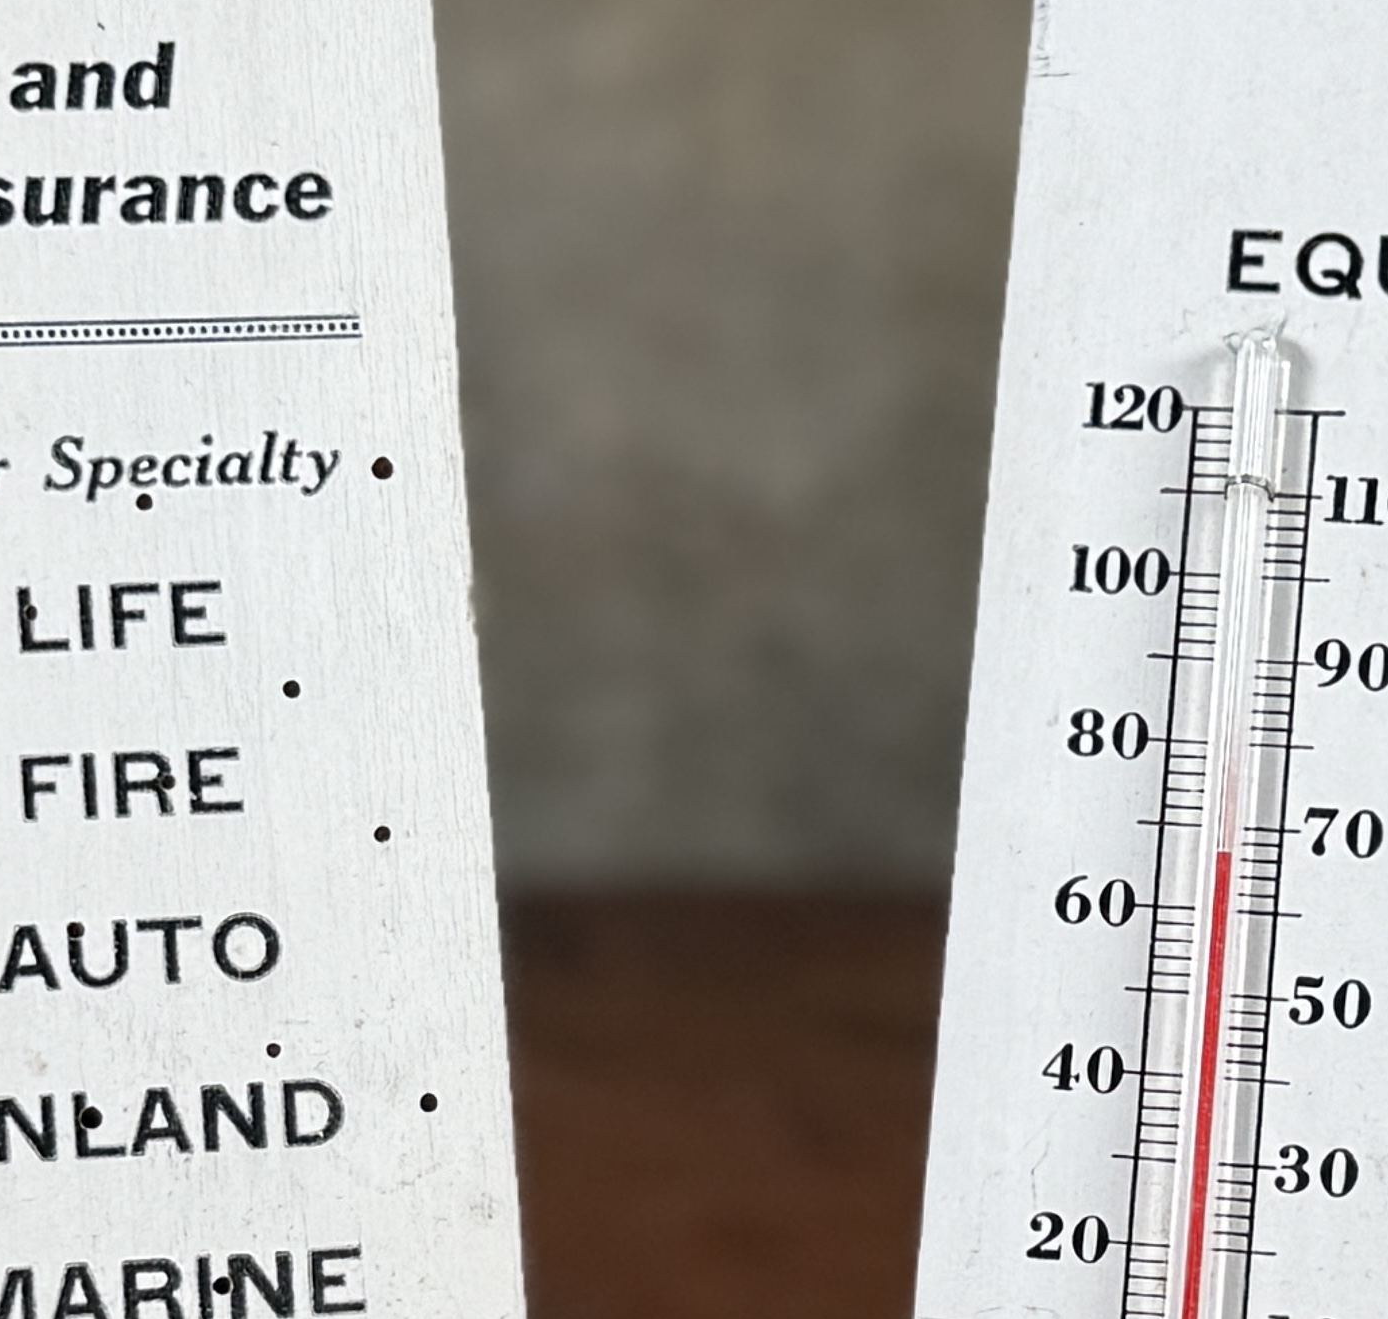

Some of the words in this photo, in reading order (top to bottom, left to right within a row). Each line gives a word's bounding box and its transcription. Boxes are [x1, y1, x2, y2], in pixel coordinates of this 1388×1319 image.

[8, 40, 176, 112] and
[1081, 380, 1185, 433] 120
[43, 429, 343, 503] Specialty
[1070, 544, 1172, 596] 100
[15, 580, 227, 653] LIFE
[1067, 707, 1150, 761] 80
[19, 746, 245, 821] FIRE
[1303, 806, 1385, 860] 70
[1053, 874, 1137, 928] 60
[1287, 975, 1373, 1030] 50
[1041, 1043, 1125, 1094] 40
[1273, 1143, 1360, 1198] 30
[1024, 1211, 1111, 1264] 20
